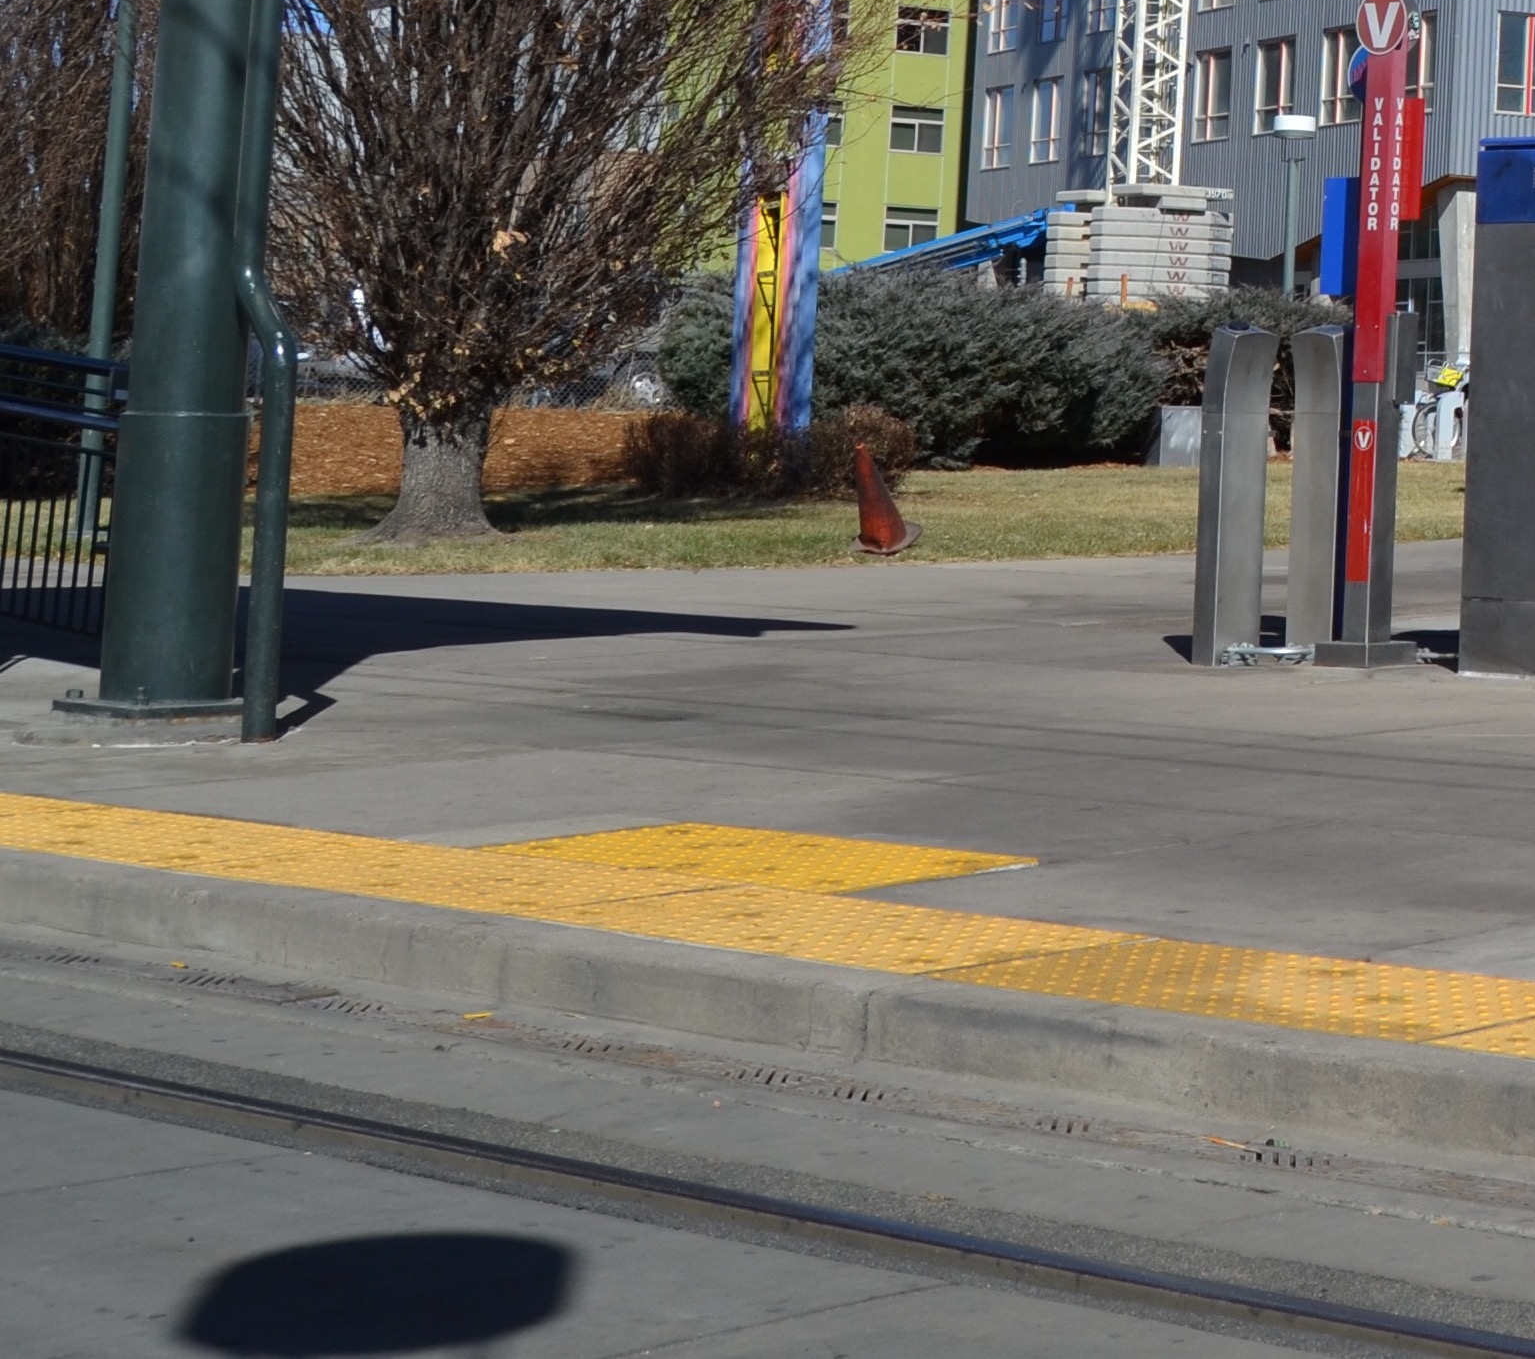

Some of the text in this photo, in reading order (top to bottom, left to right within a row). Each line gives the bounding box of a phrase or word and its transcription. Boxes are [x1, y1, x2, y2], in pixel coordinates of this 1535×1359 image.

[1364, 2, 1400, 49] V
[1367, 97, 1384, 231] VALIDATOR
[1390, 97, 1404, 231] VALIDATOR
[1358, 431, 1371, 448] V
